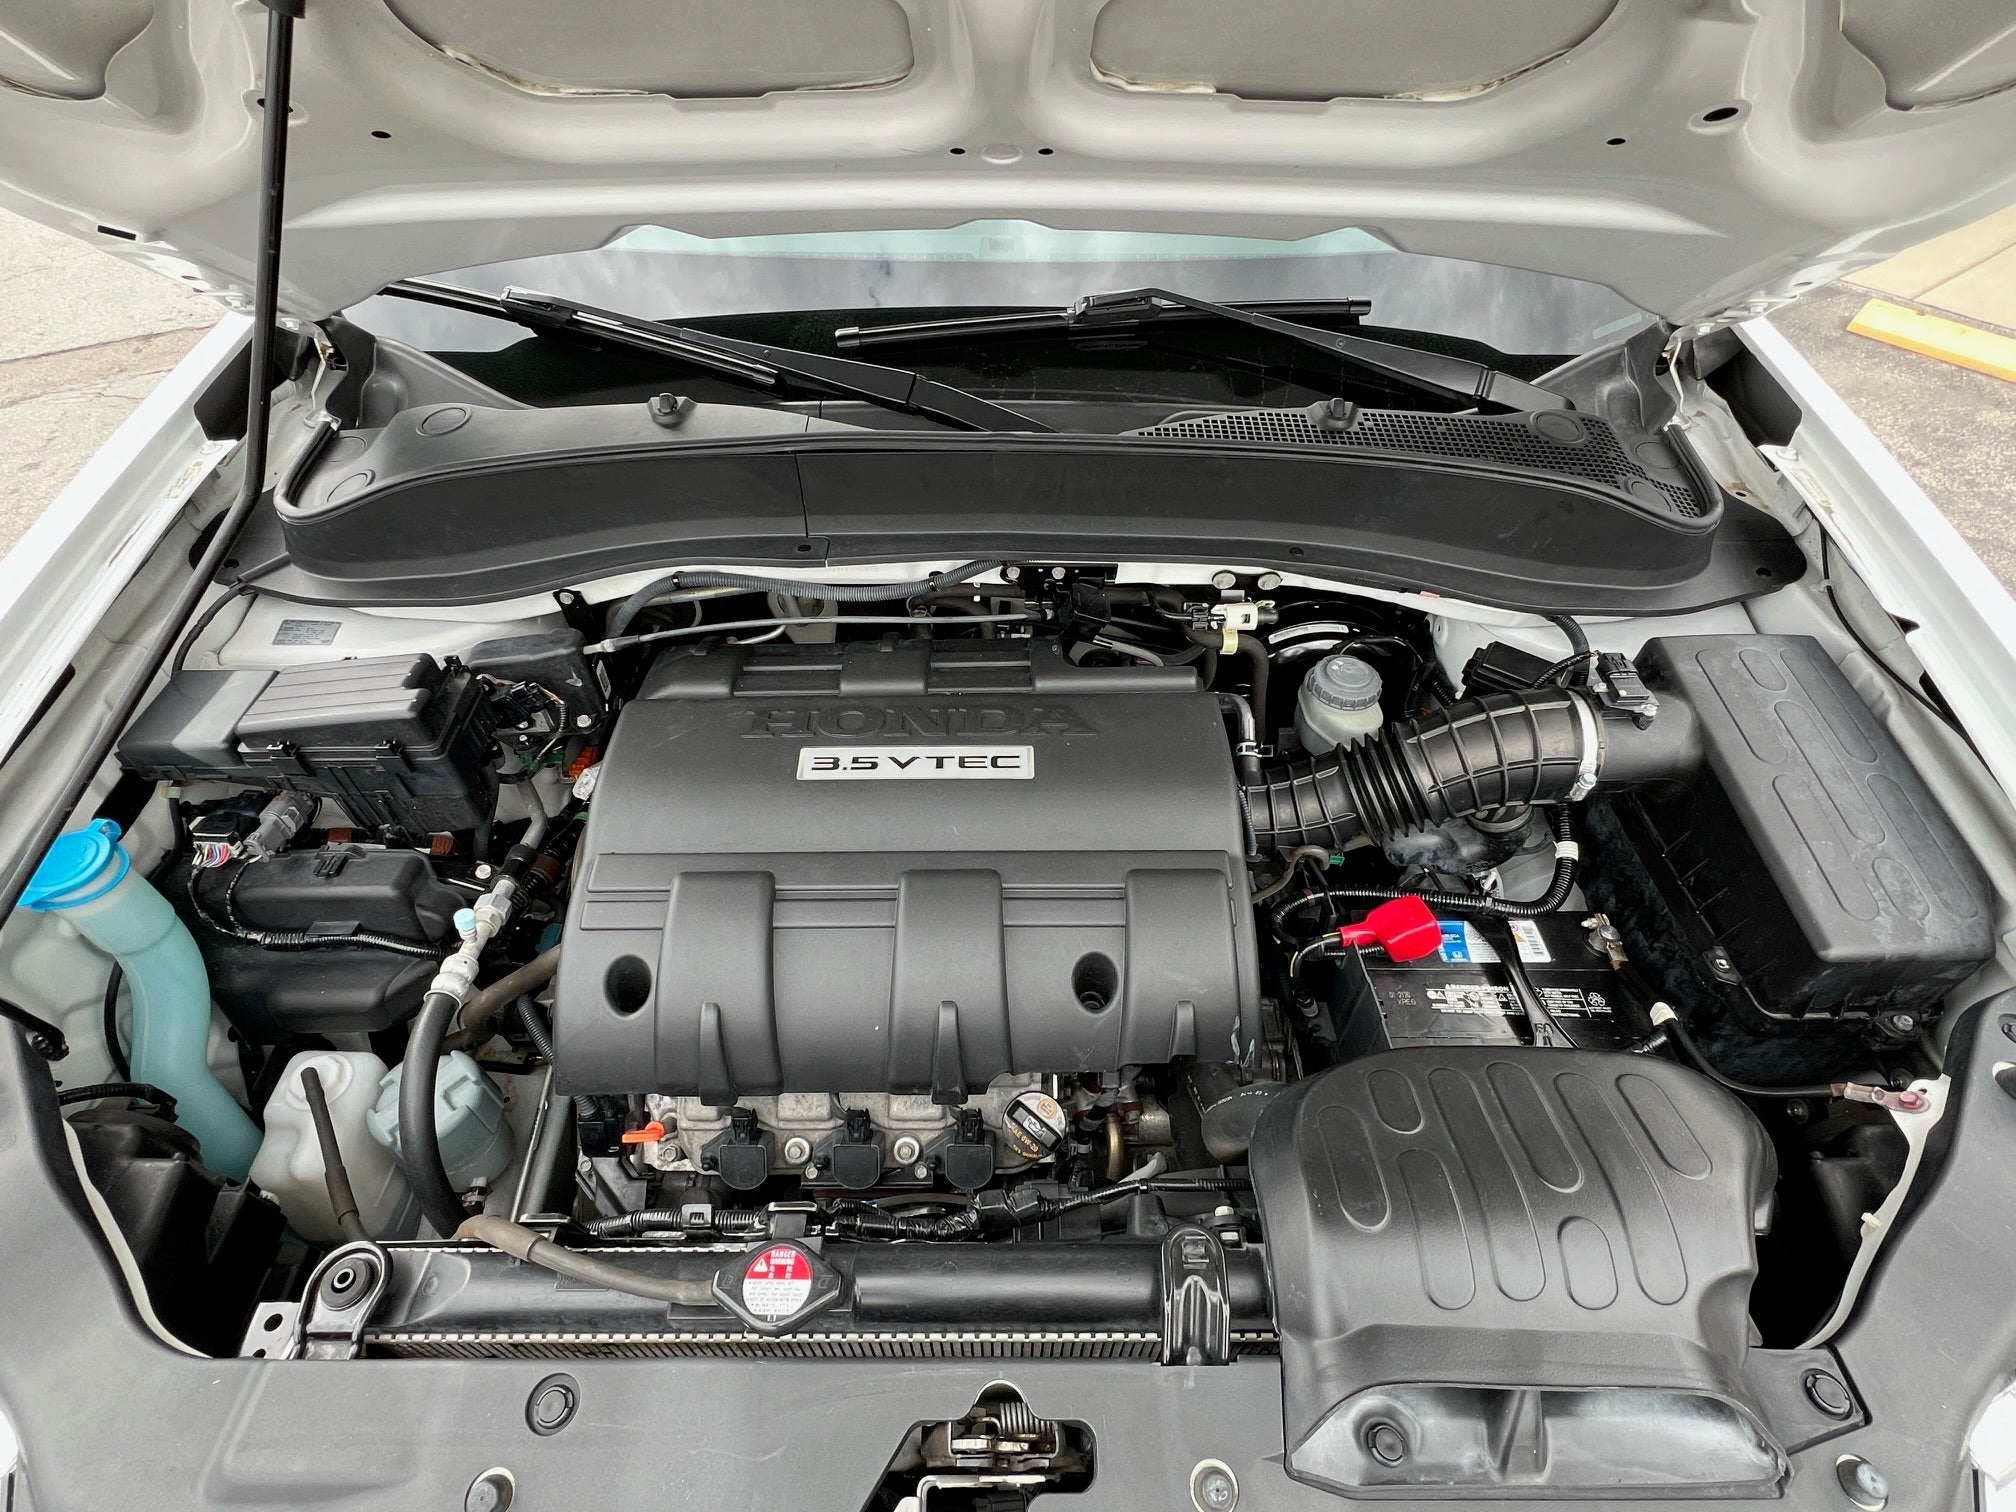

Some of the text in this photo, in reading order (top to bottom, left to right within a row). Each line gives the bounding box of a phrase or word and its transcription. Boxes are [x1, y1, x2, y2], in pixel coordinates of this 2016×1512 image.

[739, 704, 1098, 738] HONDA
[811, 756, 1021, 771] 3.5 VTEC
